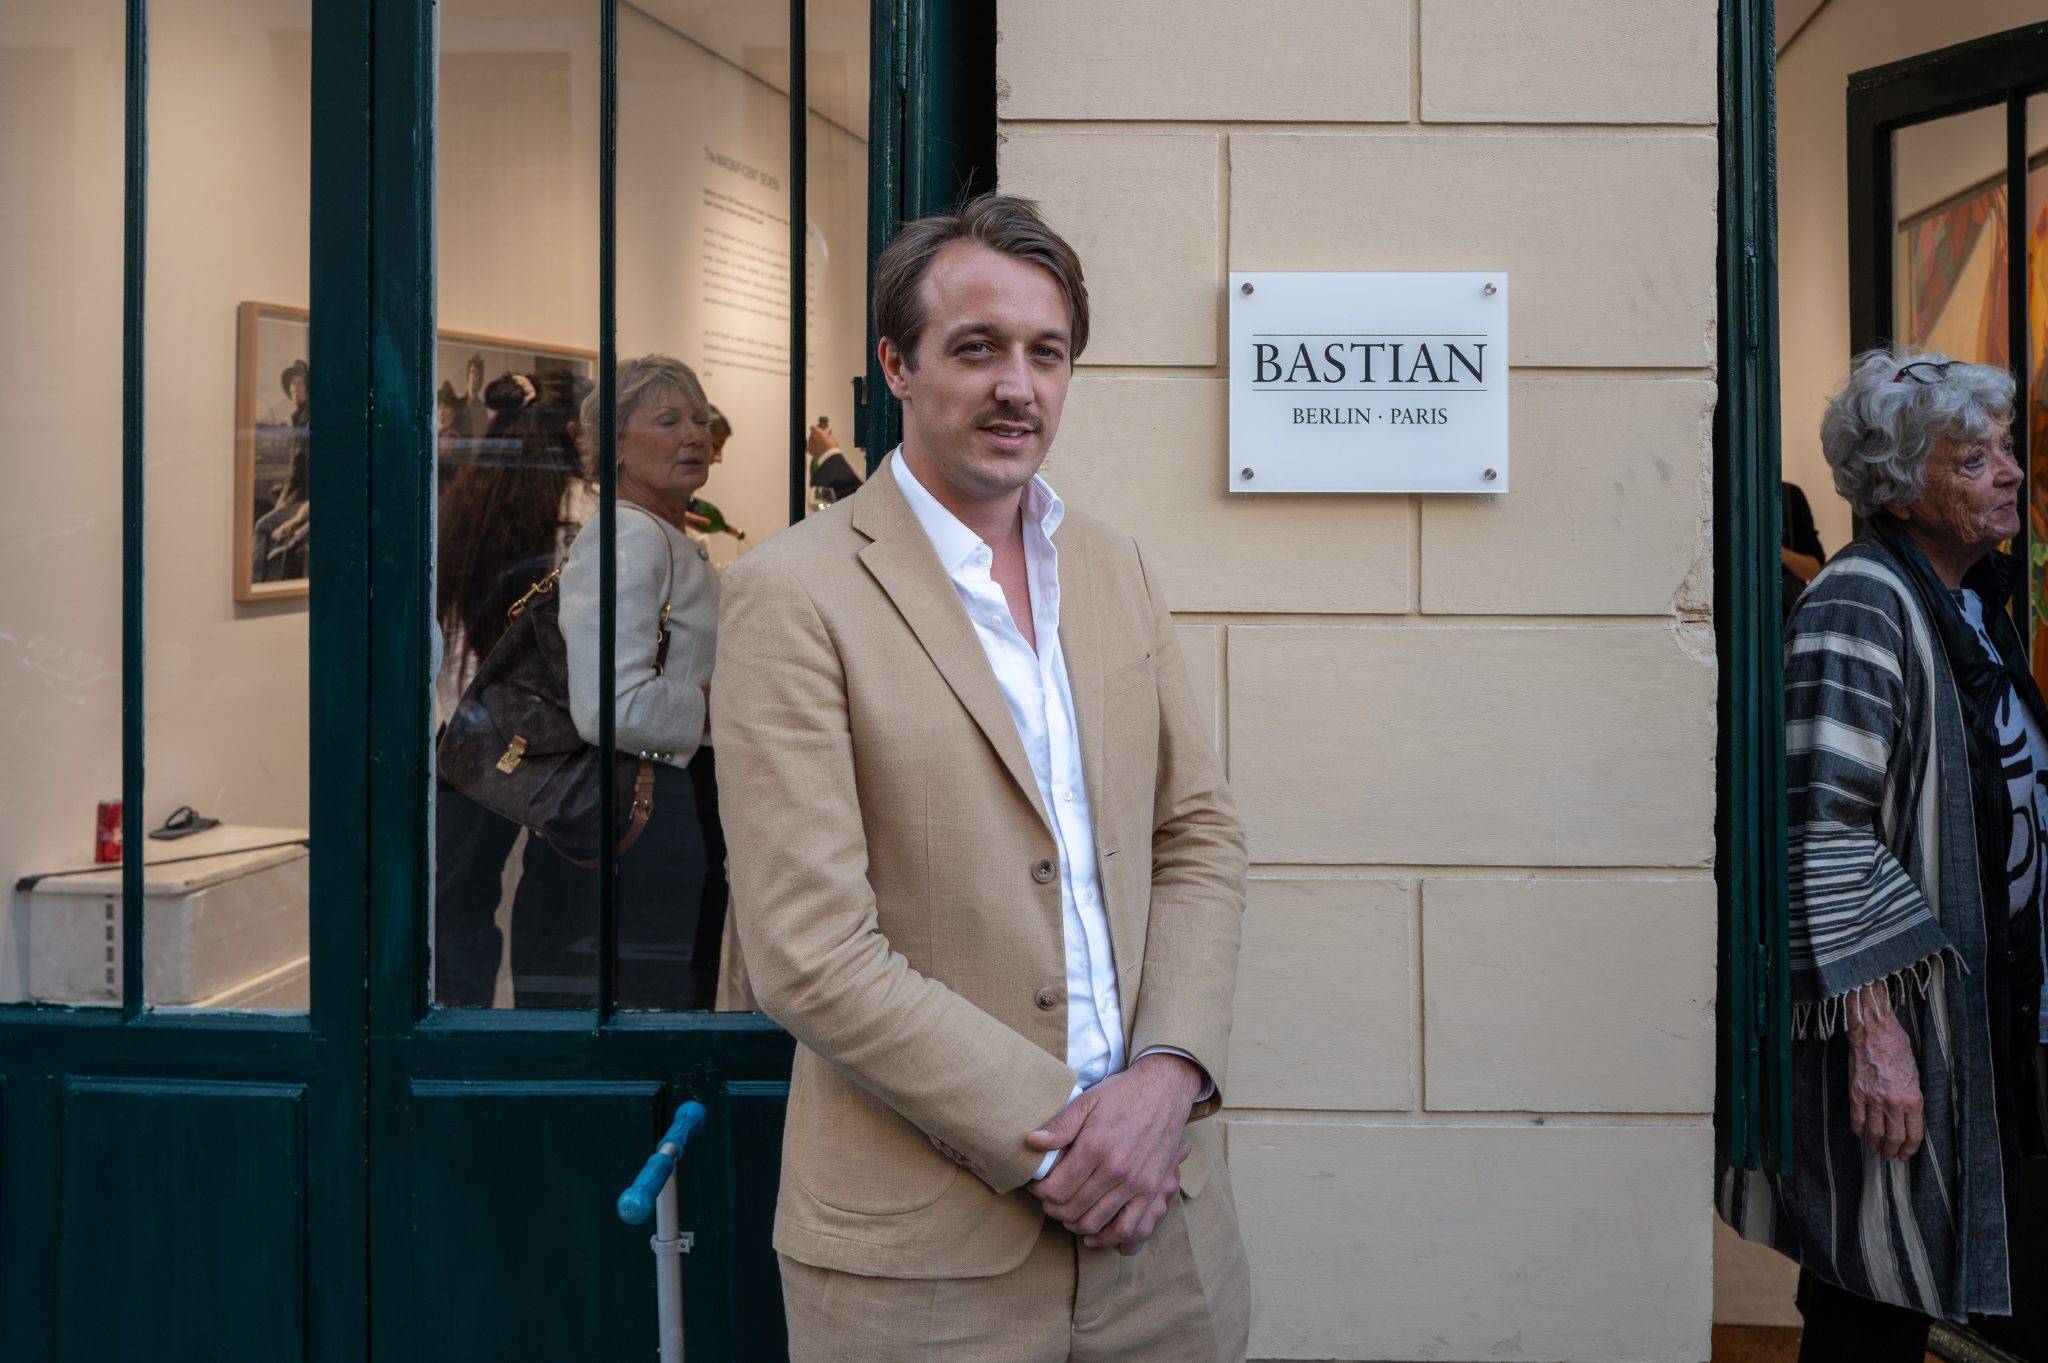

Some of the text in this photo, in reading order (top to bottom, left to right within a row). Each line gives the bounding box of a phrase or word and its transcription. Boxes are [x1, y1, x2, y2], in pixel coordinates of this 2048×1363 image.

[1252, 343, 1487, 383] BASTIAN
[1293, 408, 1447, 424] BERLIN PARIS
